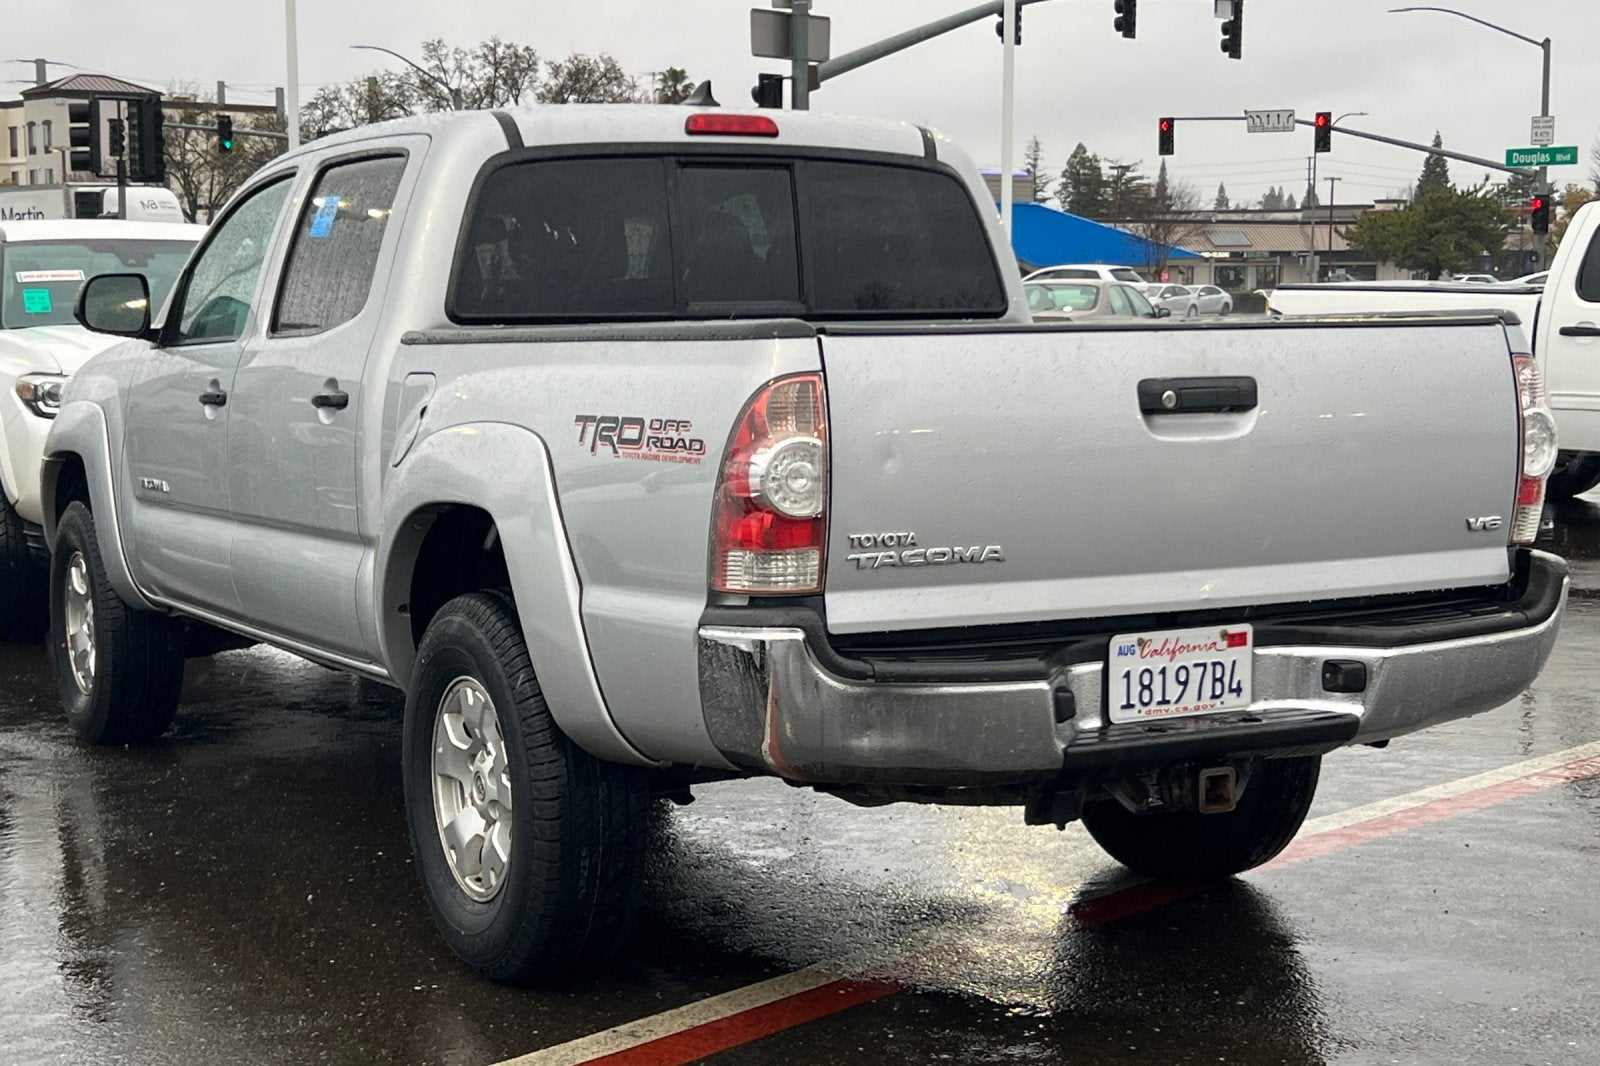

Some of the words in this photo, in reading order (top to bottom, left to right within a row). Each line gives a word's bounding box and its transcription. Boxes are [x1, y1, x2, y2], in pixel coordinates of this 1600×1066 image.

[1512, 152, 1550, 165] Douglas
[1555, 154, 1571, 162] Blvd
[574, 414, 646, 458] TRD
[648, 418, 693, 435] OFF
[646, 436, 706, 456] ROAD
[622, 452, 641, 461] TOYOTA
[641, 453, 661, 463] RACING
[661, 454, 702, 465] DEVELOPMENT
[1466, 515, 1502, 532] V6
[848, 532, 918, 549] TOYOTA
[846, 545, 1006, 571] TACOMA
[1117, 644, 1136, 657] AUG
[1140, 637, 1227, 662] California
[1120, 659, 1243, 710] 18197B4
[1144, 702, 1217, 716] dmv.ca.gov
